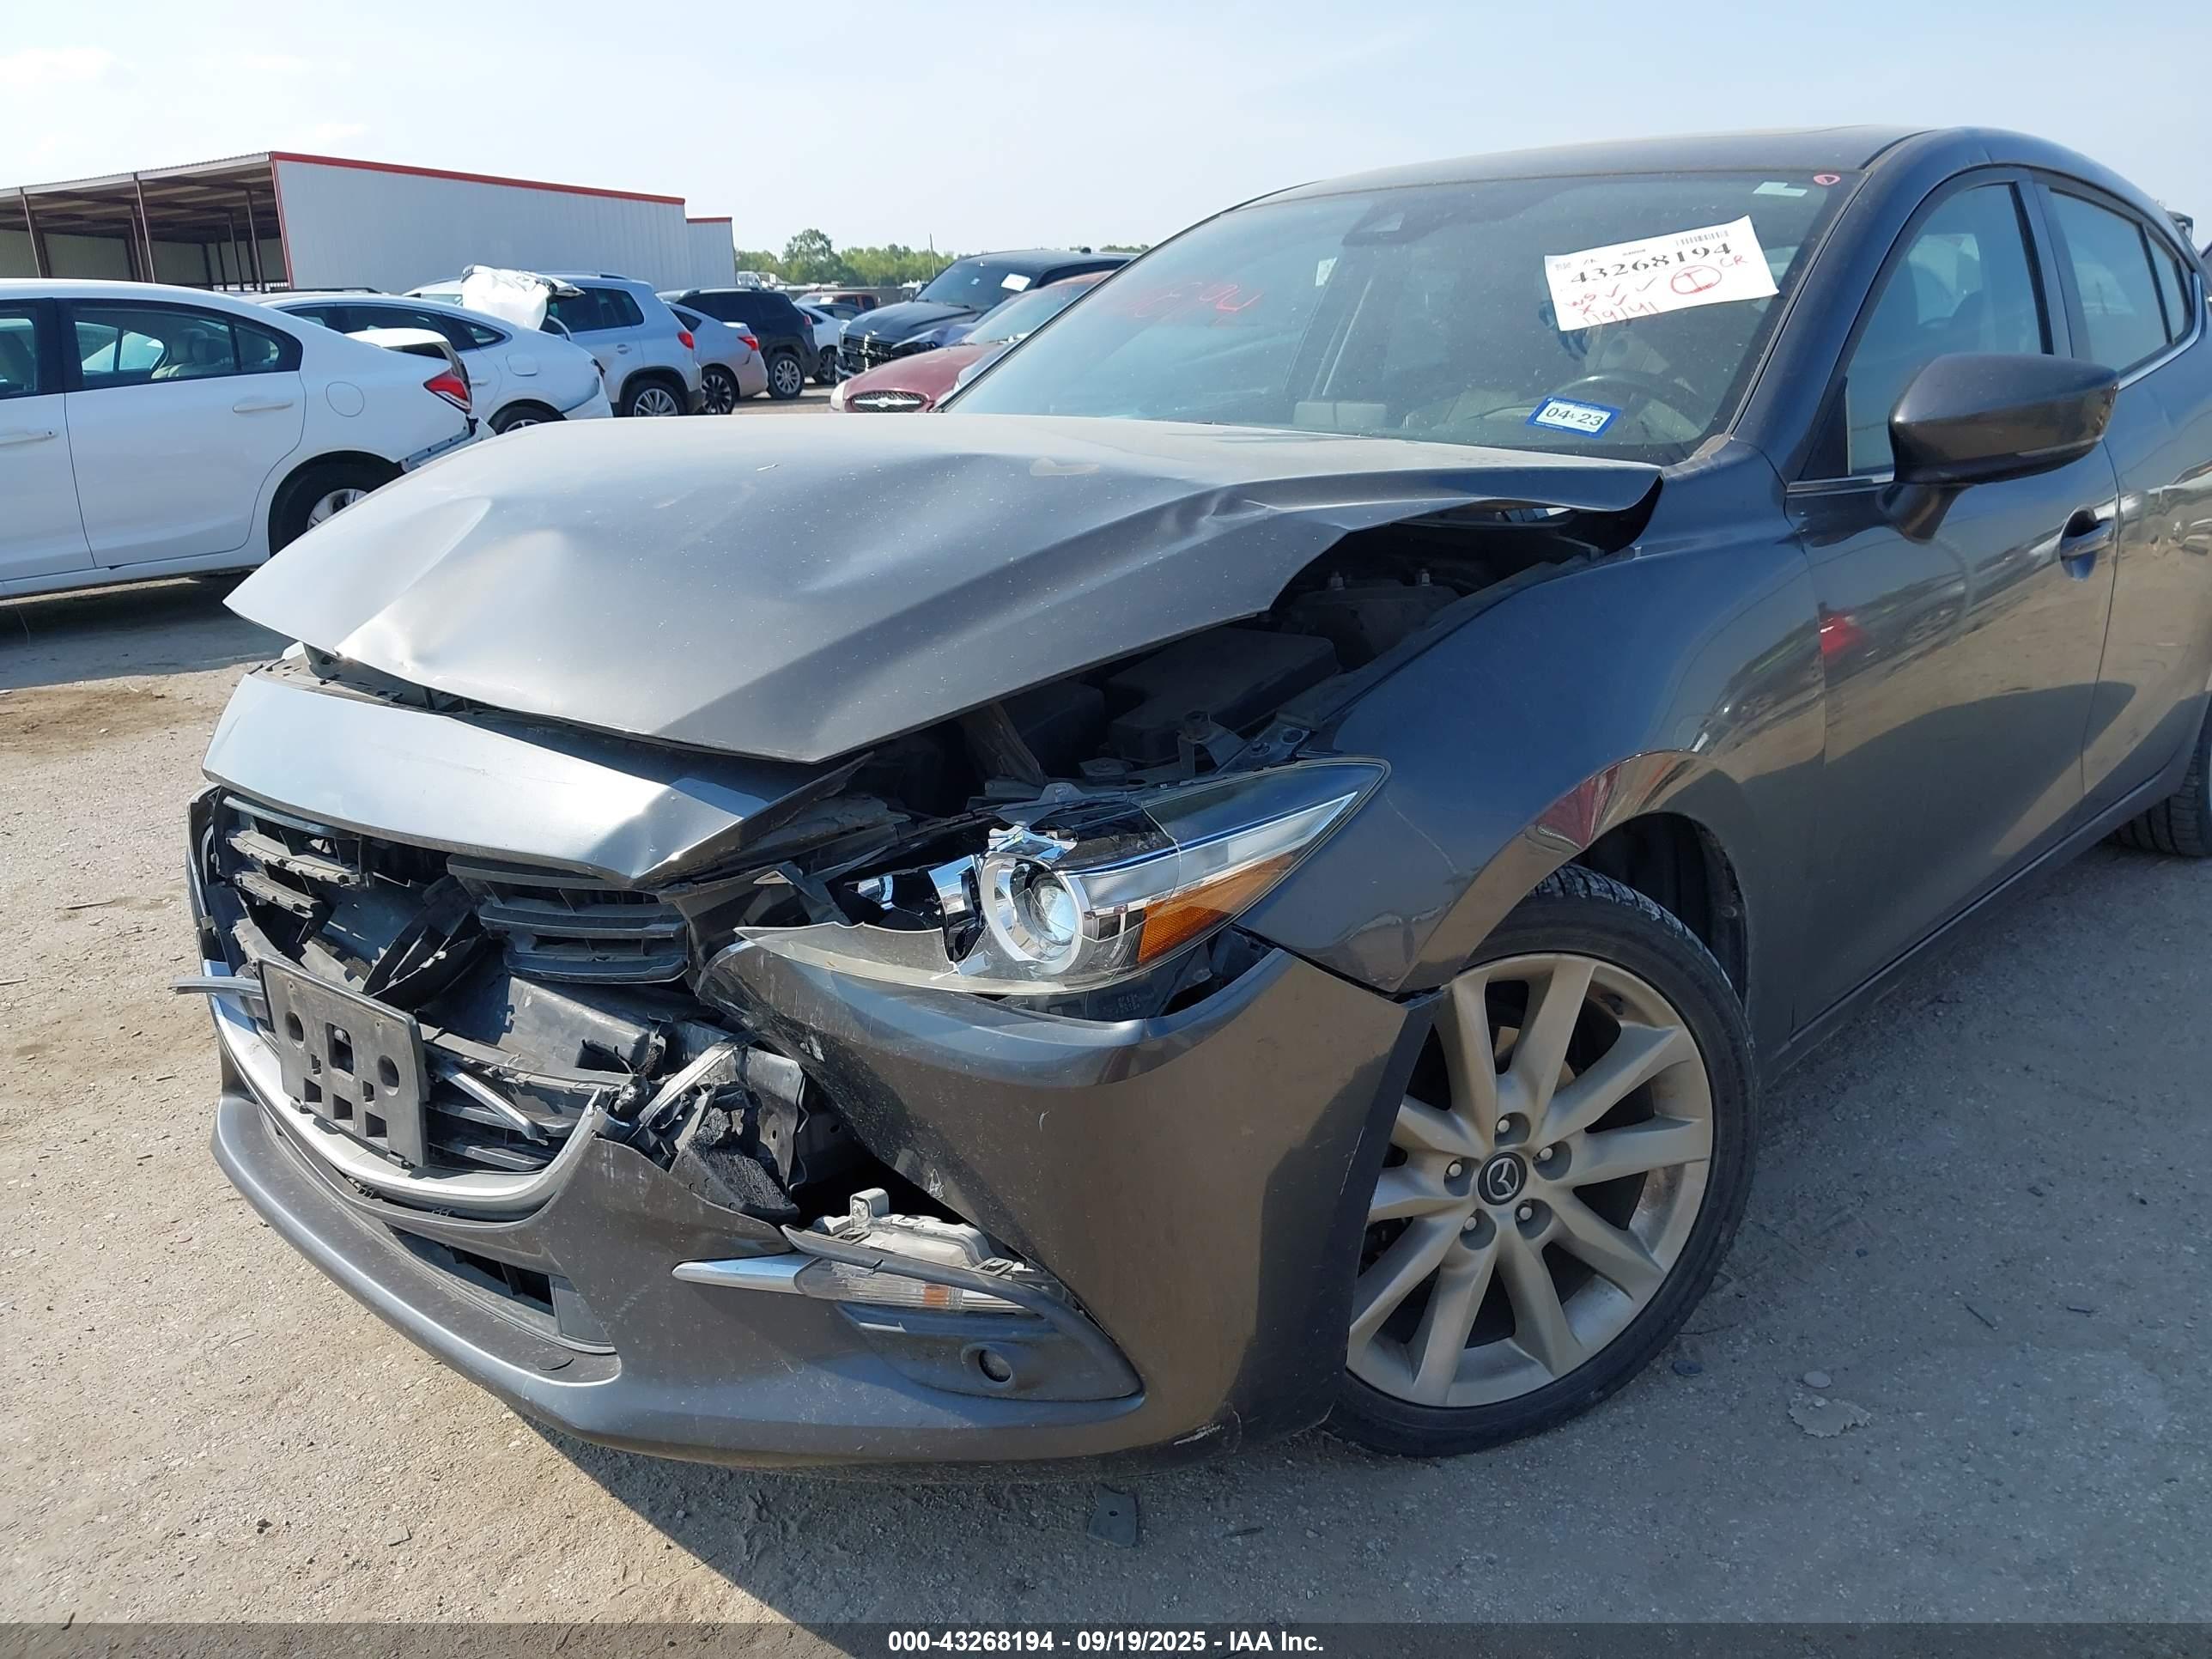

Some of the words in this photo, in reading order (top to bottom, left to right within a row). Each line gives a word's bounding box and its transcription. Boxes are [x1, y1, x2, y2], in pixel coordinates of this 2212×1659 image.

[1571, 242, 1731, 283] 43268194
[1546, 407, 1571, 420] 04
[1577, 413, 1603, 426] 23
